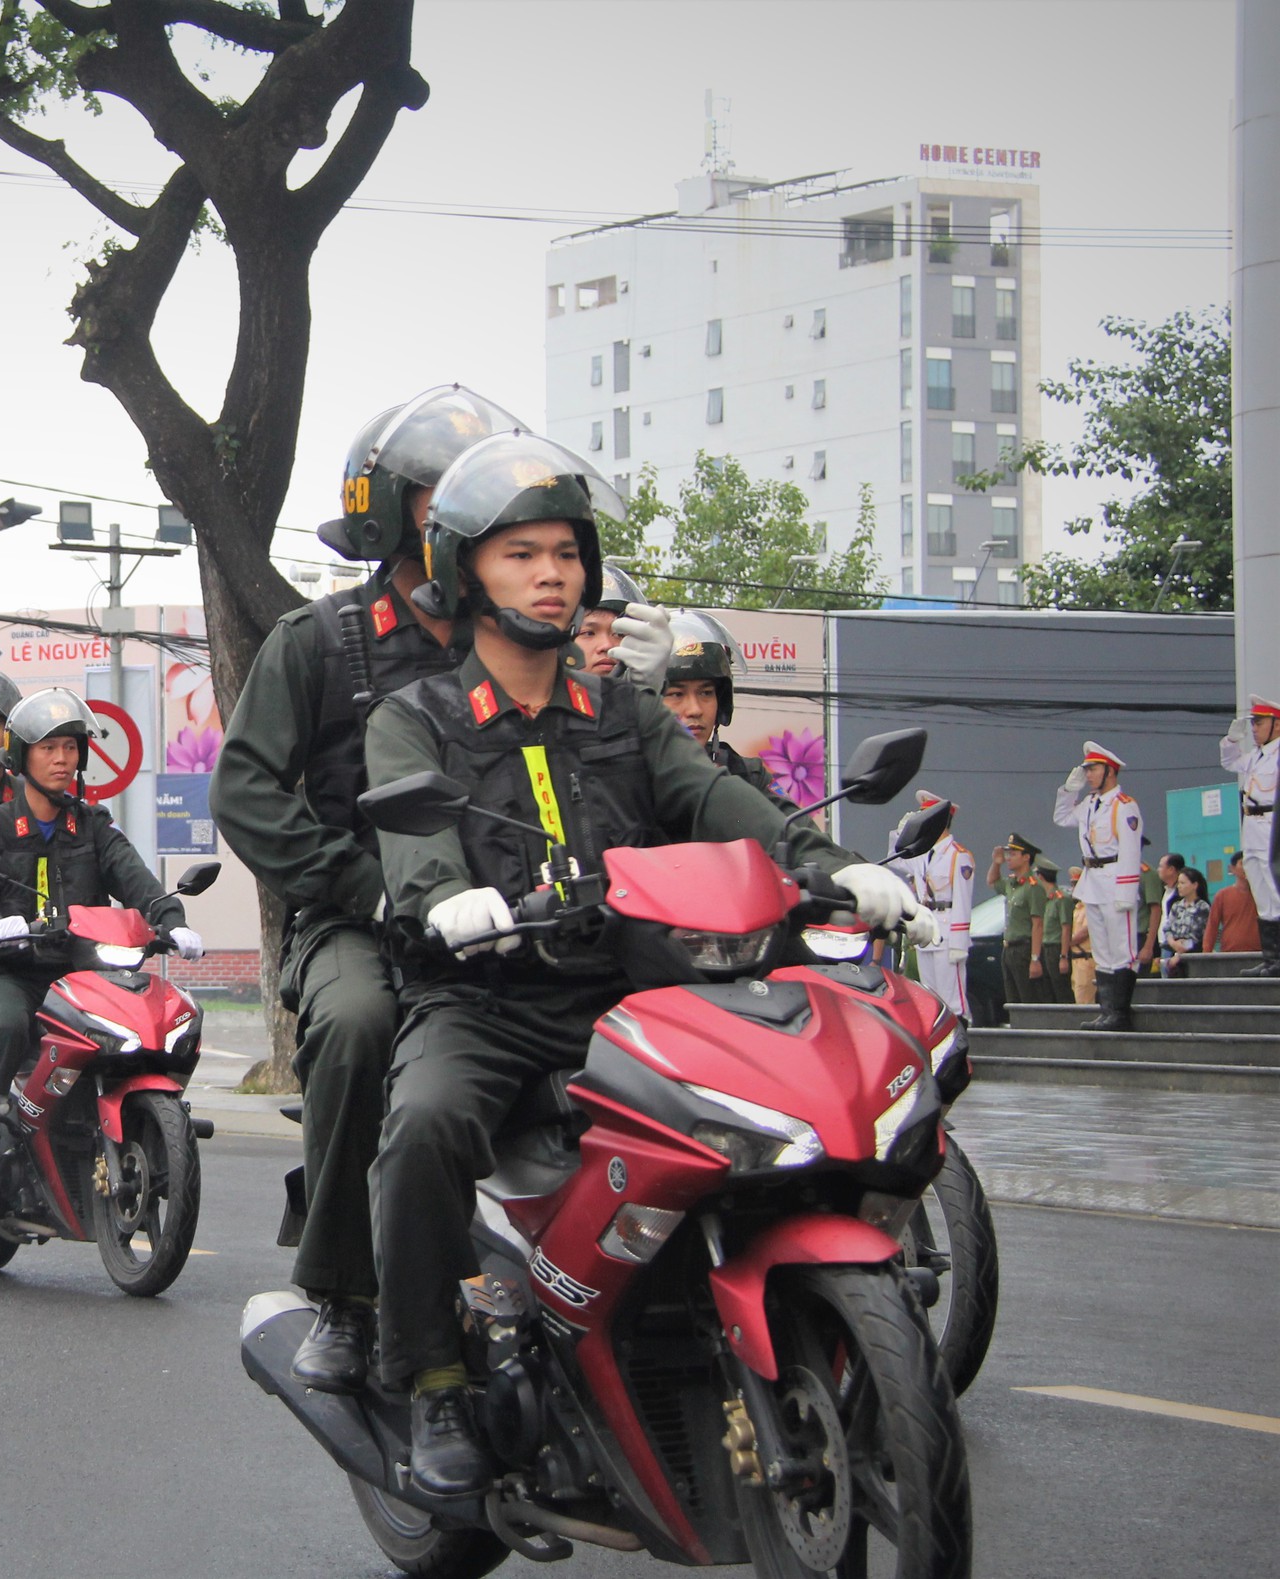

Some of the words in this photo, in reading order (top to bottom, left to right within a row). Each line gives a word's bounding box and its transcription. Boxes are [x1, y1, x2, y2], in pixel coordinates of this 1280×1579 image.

[920, 144, 968, 163] HOME
[973, 147, 1040, 168] CENTER
[11, 642, 32, 662] LÊ
[737, 636, 796, 660] UYỄN
[536, 772, 558, 839] POLI
